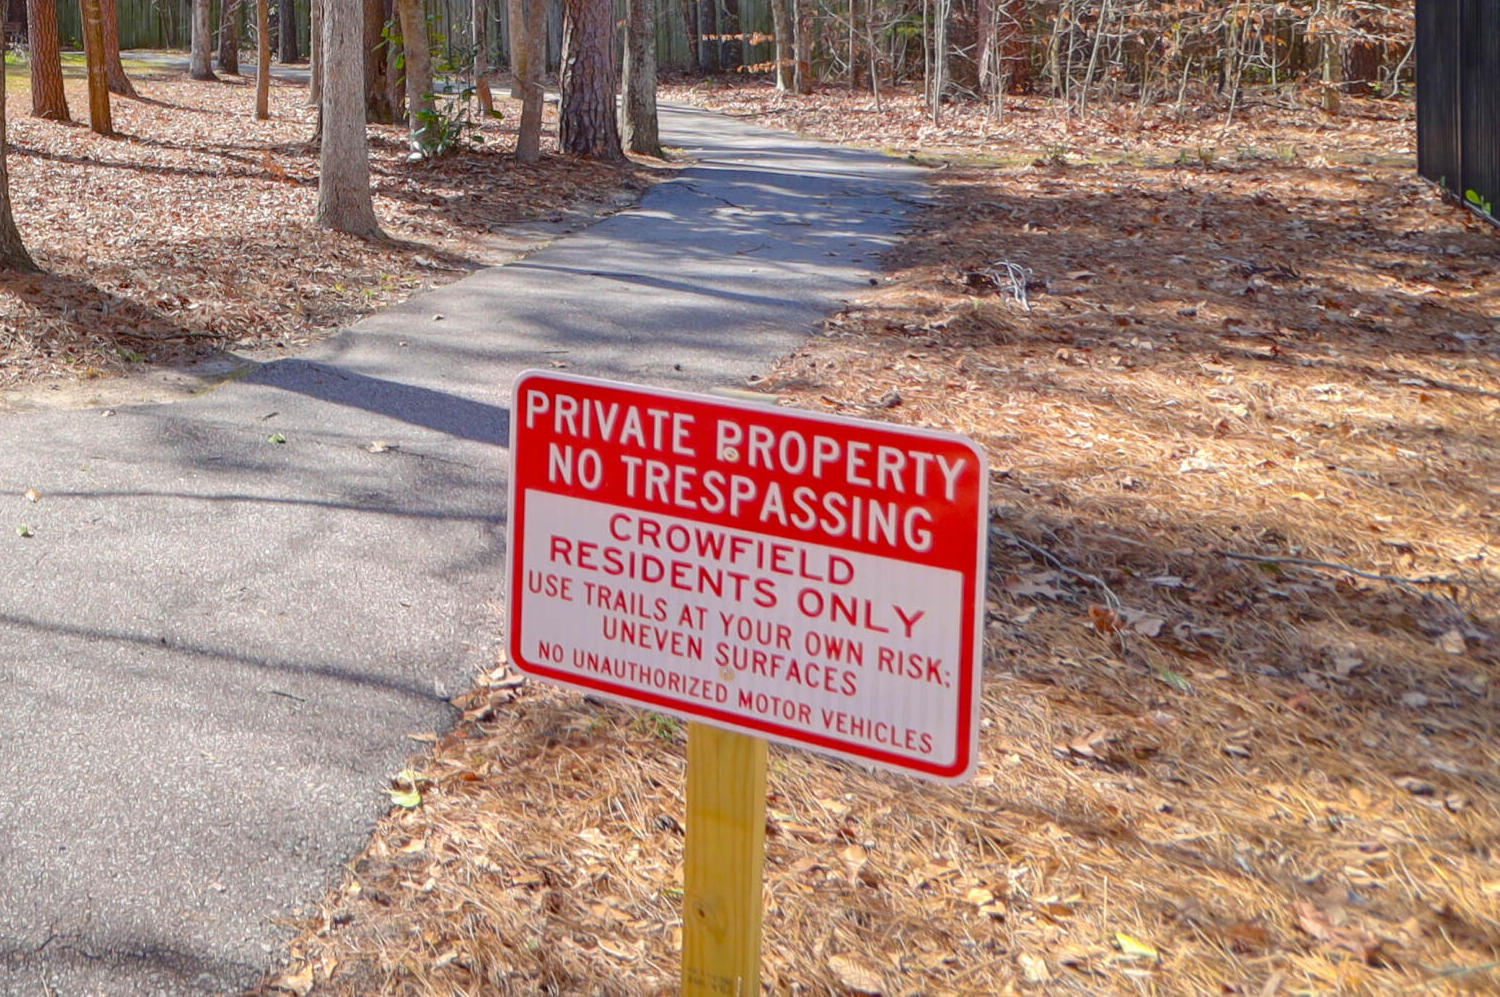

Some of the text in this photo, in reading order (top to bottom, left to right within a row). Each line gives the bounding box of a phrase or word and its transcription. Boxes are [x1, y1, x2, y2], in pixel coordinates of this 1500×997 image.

[526, 389, 966, 500] PRIVATE PROPERTY
[548, 443, 933, 552] NO TRESPASSING
[610, 513, 854, 585] CROWFIELD
[528, 570, 573, 602] USE
[585, 582, 667, 620] TRAILS
[679, 606, 708, 630] AT
[720, 613, 791, 650] YOUR
[805, 631, 863, 666] OWN
[550, 535, 925, 638] RESIDENTS ONLY
[538, 641, 933, 754] NO UNAUTHORIZED MOTOR VEHICLES
[603, 616, 856, 696] UNEVEN SURFACES
